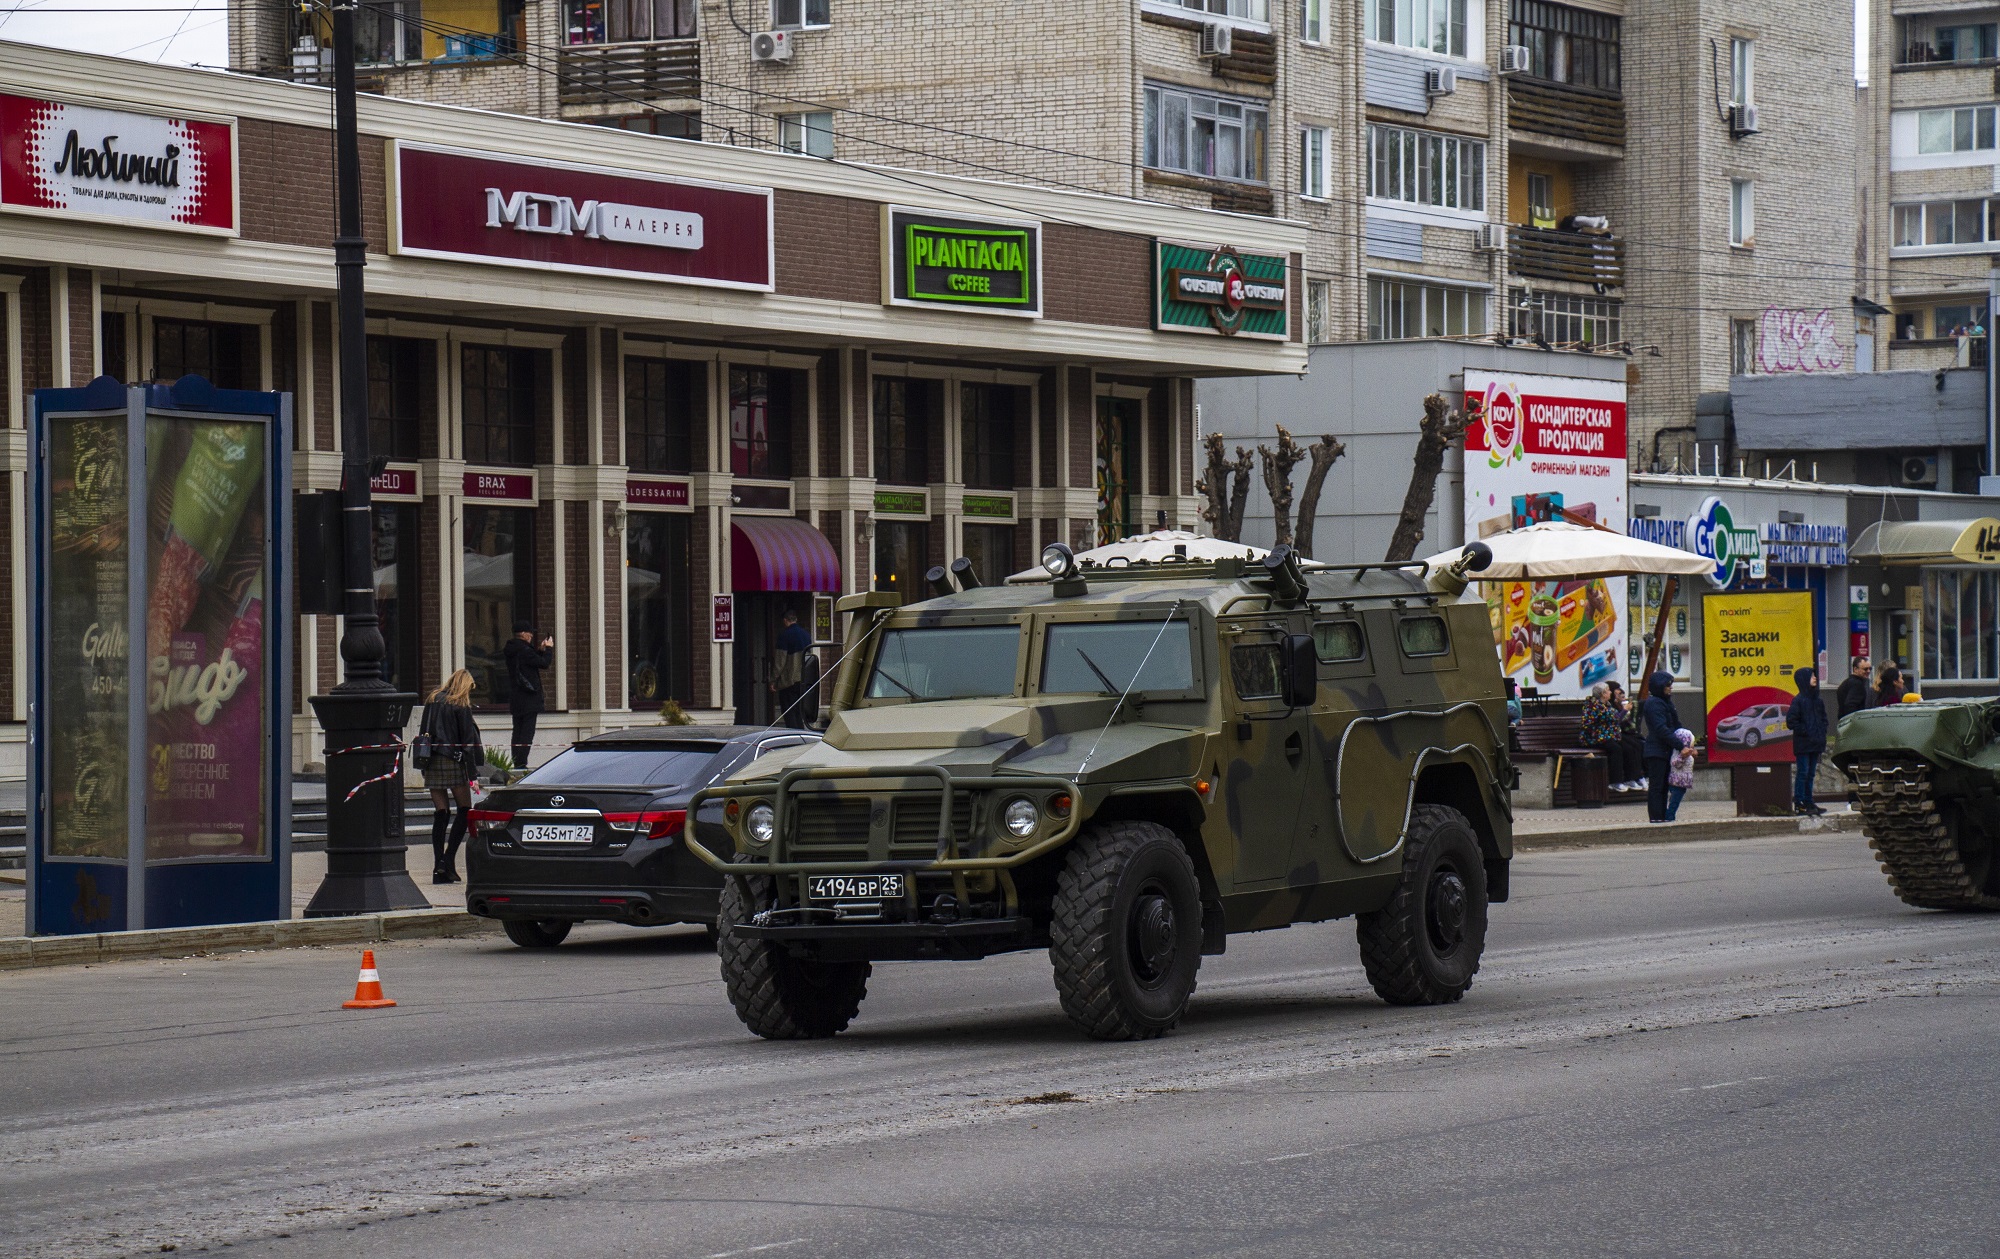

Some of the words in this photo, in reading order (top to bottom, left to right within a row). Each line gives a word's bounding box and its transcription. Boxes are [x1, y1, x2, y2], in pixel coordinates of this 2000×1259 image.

[55, 129, 181, 188] Любимый
[72, 187, 93, 197] ТОВАРЫ
[93, 189, 104, 199] ДЛЯ
[613, 215, 693, 237] ГАЛЕРЕЯ
[915, 235, 1024, 271] PLANTACIA
[947, 273, 990, 293] COFFEE
[1180, 277, 1225, 295] GUSTAV
[1231, 280, 1245, 300] &
[1244, 284, 1285, 300] GUSTAV
[1493, 406, 1514, 422] KDV
[1530, 404, 1612, 428] КОНДИТЕРСКАЯ
[1538, 429, 1604, 453] ПРОДУКЦИЯ
[1531, 461, 1577, 475] ФИРМЕННЫЙ
[1579, 463, 1610, 477] МАГАЗИН
[478, 476, 506, 489] BRAX
[1768, 522, 1781, 540] МЫ
[1785, 523, 1847, 544] КОНТРОЛИРУЕМ
[1697, 523, 1758, 566] СТОЛИЦА
[1815, 546, 1820, 564] И
[1826, 546, 1848, 565] ЦЕНЫ
[1719, 607, 1750, 616] maxim
[1720, 629, 1780, 643] Закажи
[1721, 646, 1764, 658] такси
[213, 822, 245, 830] телефону
[577, 826, 589, 837] 27
[881, 877, 898, 891] 25
